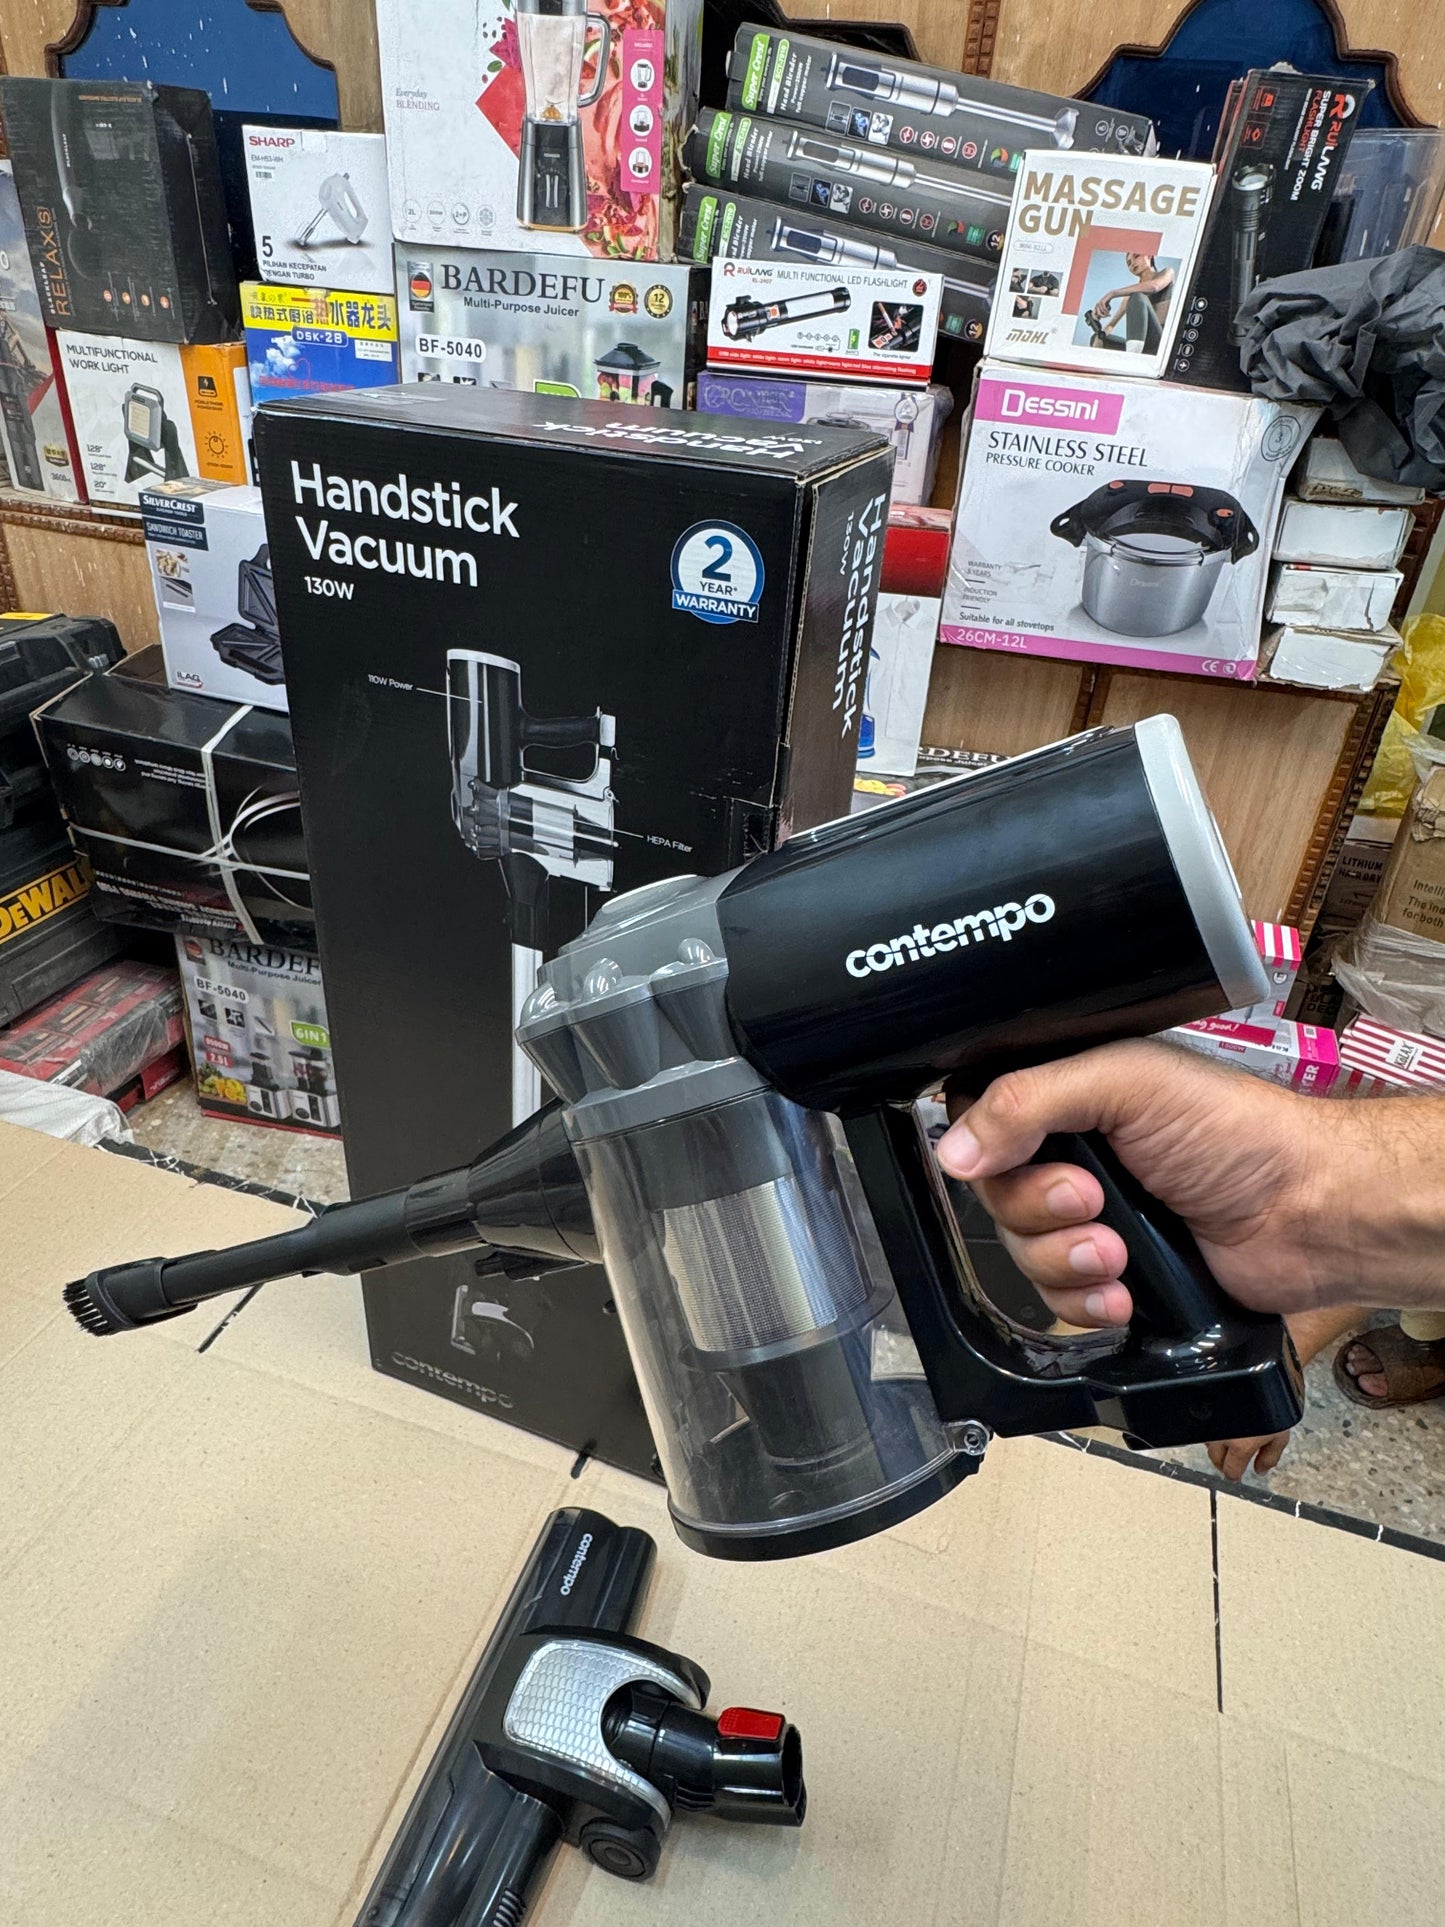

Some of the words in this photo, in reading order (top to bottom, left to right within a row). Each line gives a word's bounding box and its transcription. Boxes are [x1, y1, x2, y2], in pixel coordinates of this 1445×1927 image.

[745, 72, 759, 105] Super
[752, 40, 765, 71] Crest
[780, 88, 790, 111] Hand
[785, 52, 797, 87] Blender
[396, 88, 427, 100] Everyday
[396, 100, 440, 112] BLENDING
[1298, 90, 1322, 152] FLASHLIGHT
[1313, 90, 1331, 127] SUPER
[249, 136, 296, 148] SHARP
[713, 116, 728, 142] Crest
[746, 127, 759, 158] Blender
[1301, 129, 1318, 168] BRIGHT
[709, 141, 721, 174] Super
[743, 158, 752, 180] Hand
[1023, 171, 1202, 218] MASSAGE
[1290, 169, 1307, 201] ZOOM
[700, 202, 712, 231] Crest
[732, 215, 744, 243] Blender
[1018, 203, 1094, 238] GUN
[262, 235, 273, 258] 5
[696, 231, 708, 260] Super
[288, 262, 327, 273] KECEPATAN
[292, 271, 315, 281] TURBO
[776, 271, 799, 280] MULTI
[800, 272, 845, 284] FUNCTIONAL
[847, 276, 862, 285] LED
[863, 277, 908, 289] FLASHLIGHT
[440, 264, 606, 303] BARDEFU
[463, 296, 541, 315] Multi-Purpose
[543, 303, 580, 318] Juicer
[652, 292, 665, 303] 12
[66, 344, 158, 363] MULTIFUNCTIONAL
[419, 337, 483, 360] BF-5040
[69, 358, 100, 372] WORK
[101, 361, 130, 374] LIGHT
[532, 421, 796, 459] Handstick
[604, 422, 805, 453] Vacuum
[988, 430, 1089, 459] STAINLESS
[1093, 443, 1149, 467] STEEL
[985, 451, 1041, 470] PRESSURE
[1044, 459, 1095, 476] COOKER
[290, 459, 521, 538] Handstick
[146, 521, 178, 535] SANDWICH
[178, 523, 204, 541] TOASTER
[839, 511, 854, 576] 130W
[294, 515, 478, 587] Vacuum
[702, 535, 733, 583] 2
[967, 560, 1002, 570] WARRANTY
[304, 576, 355, 601] 130W
[961, 594, 992, 604] FRIENDLY
[963, 586, 998, 597] INDUCTION
[675, 593, 756, 618] WARRANTY
[832, 497, 874, 711] Vacuum
[841, 493, 886, 739] Handstick
[959, 611, 991, 624] Suitable
[992, 615, 1004, 625] for
[1004, 617, 1015, 627] all
[1016, 619, 1055, 633] stovetops
[957, 628, 1027, 649] 26CM-12L
[388, 677, 414, 691] Power
[646, 834, 671, 848] HEPA
[672, 838, 693, 853] Filter
[1342, 855, 1383, 871] LITHIUM
[1413, 879, 1445, 897] Intelli
[0, 867, 89, 938] DEWAL
[1408, 896, 1427, 910] The
[1402, 907, 1418, 920] for
[1419, 914, 1444, 928] both
[845, 893, 1056, 978] contempo
[208, 938, 321, 976] BARDEF
[227, 960, 291, 980] Multi-Purpose
[292, 974, 322, 987] Juicer
[196, 977, 247, 1002] BF-5040
[391, 1351, 514, 1409] contempo
[560, 1533, 593, 1596] contempo
